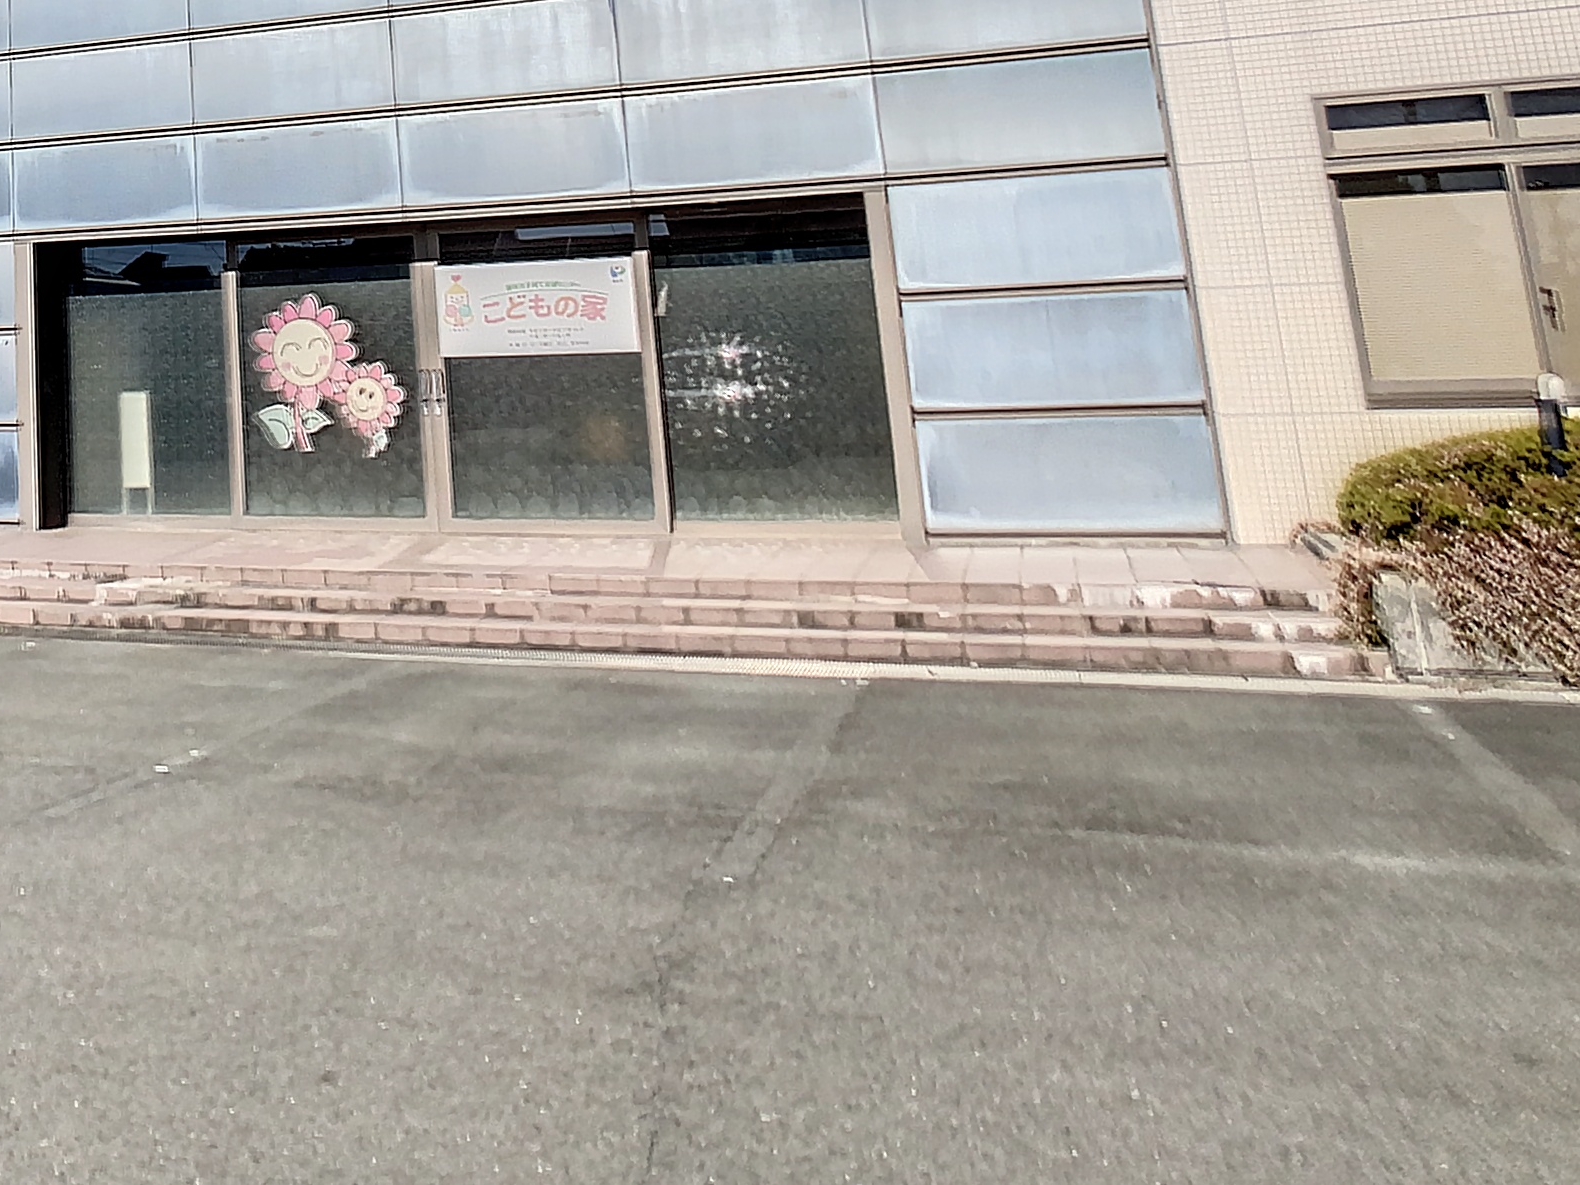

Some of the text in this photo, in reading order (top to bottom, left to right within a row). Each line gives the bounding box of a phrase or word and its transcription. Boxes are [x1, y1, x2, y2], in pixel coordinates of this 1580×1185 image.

[482, 294, 608, 324] こどもの家
